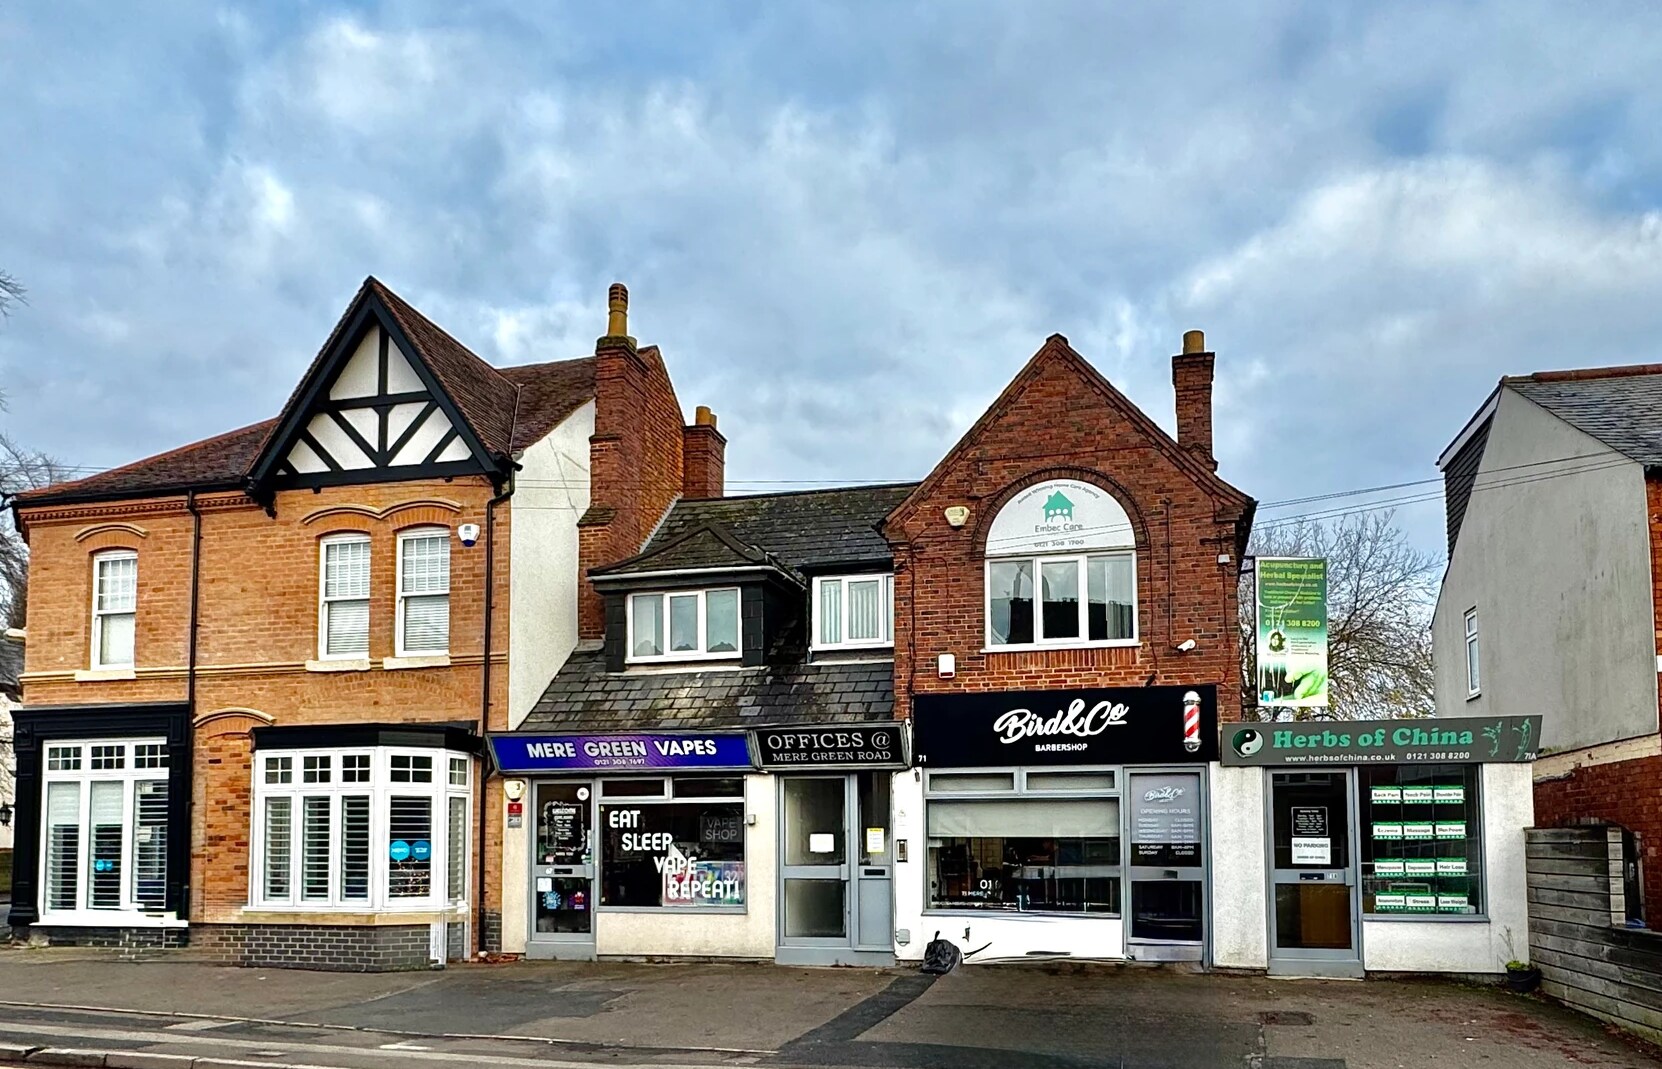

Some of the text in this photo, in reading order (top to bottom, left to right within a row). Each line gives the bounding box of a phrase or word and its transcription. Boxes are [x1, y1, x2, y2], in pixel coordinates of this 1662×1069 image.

[1034, 523, 1083, 533] Embec Care
[1260, 561, 1308, 569] Acupuncture
[1260, 571, 1286, 579] Herbal
[993, 698, 1130, 744] Bird&Co
[767, 731, 891, 750] OFFICES @
[1273, 727, 1474, 748] Herbs of China
[526, 739, 718, 758] MERE GREEN VAPES
[1035, 743, 1088, 752] BARBERSHOP
[772, 750, 892, 762] MERE GREEN ROAD
[1285, 751, 1470, 762] www.herbsofchina.co.uk 0121 308 8200
[609, 810, 641, 828] EAT
[707, 819, 737, 828] VAPE
[621, 833, 673, 851] SLEEP
[705, 829, 738, 840] SHOP
[653, 856, 697, 875] VAPE
[667, 879, 740, 900] REPEAT!
